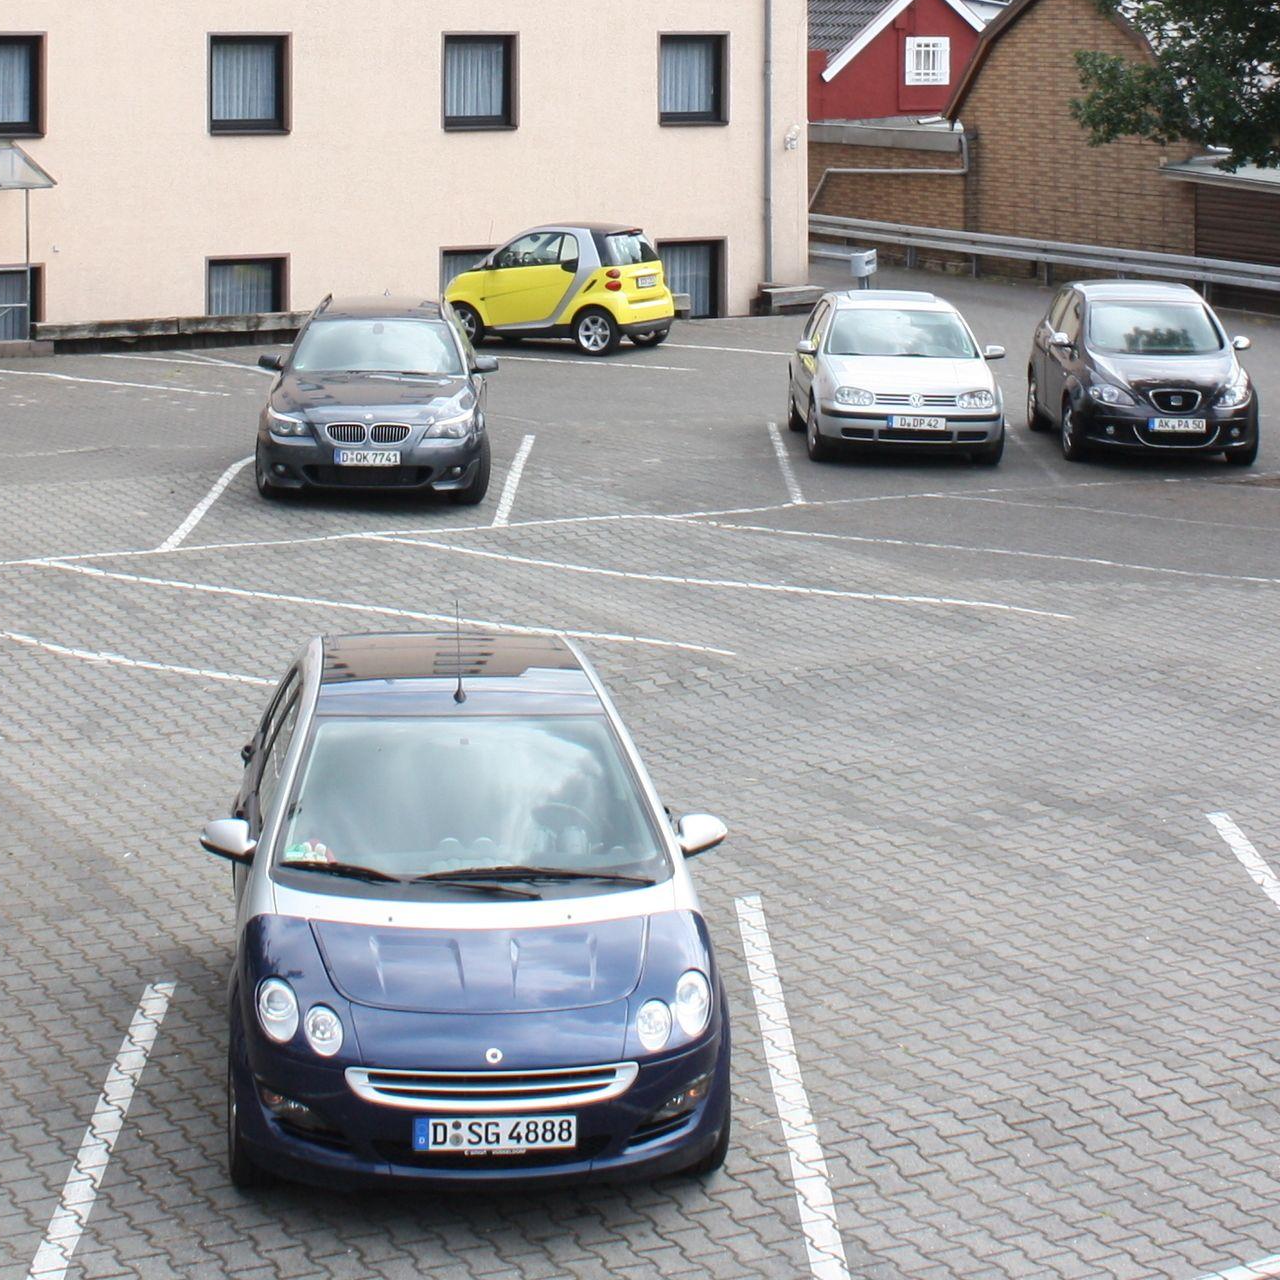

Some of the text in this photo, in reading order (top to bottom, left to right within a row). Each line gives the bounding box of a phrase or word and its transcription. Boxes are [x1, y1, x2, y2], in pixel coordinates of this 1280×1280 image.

[431, 1118, 573, 1146] D SG 4888
